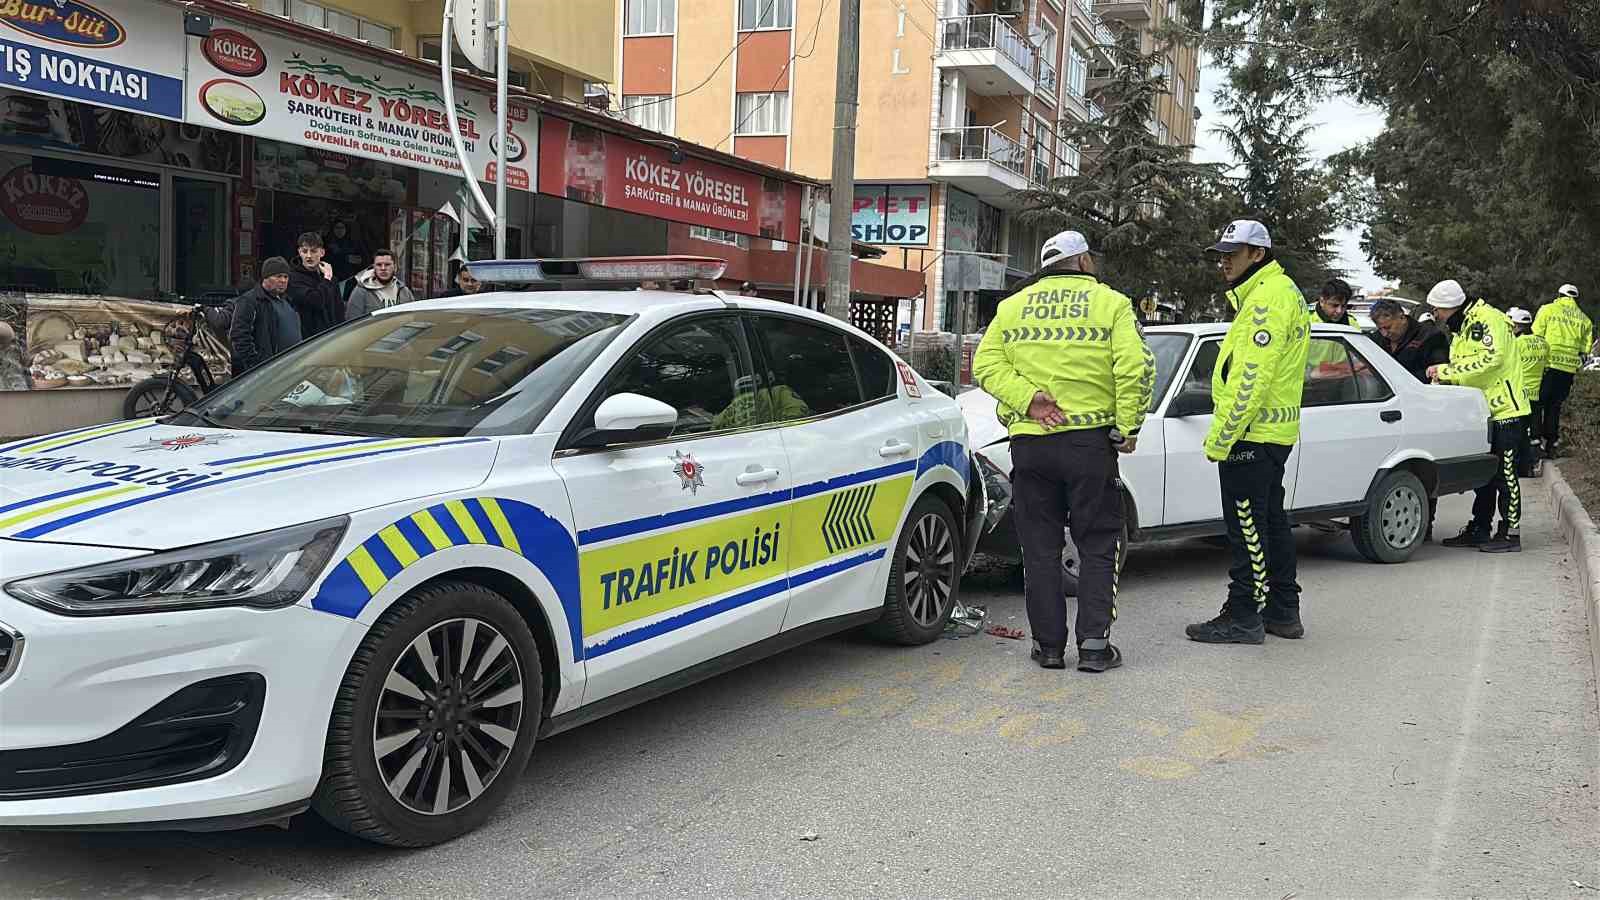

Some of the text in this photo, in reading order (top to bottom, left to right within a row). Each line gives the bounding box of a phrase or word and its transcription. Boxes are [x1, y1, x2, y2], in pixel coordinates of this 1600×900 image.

[213, 38, 257, 62] KÖKEZ
[0, 45, 148, 101] IŞ NOKTASI
[280, 71, 371, 113] KÖKEZ
[378, 97, 480, 139] YÖRESEL
[287, 99, 361, 127] ŞARKÜTERİ
[366, 118, 374, 129] &
[378, 120, 419, 140] MANAV
[422, 129, 475, 153] ÜRÜNRİ
[310, 119, 354, 137] Doğadan
[304, 130, 359, 150] GÜVENİLİR
[362, 142, 388, 157] GIDA,
[390, 148, 431, 164] SAĞLIKLI
[625, 155, 749, 207] KÖKEZ YÖRESEL
[624, 184, 748, 221] ŞARKÜTERİ & MANAV ÜRÜNLERİ
[851, 195, 926, 213] PET
[851, 224, 927, 241] SHOP
[1021, 303, 1089, 320] POLİSİ
[1027, 288, 1091, 305] TRAFİK
[67, 461, 223, 489] POLİSİ
[600, 522, 780, 610] TRAFİK POLİSİ
